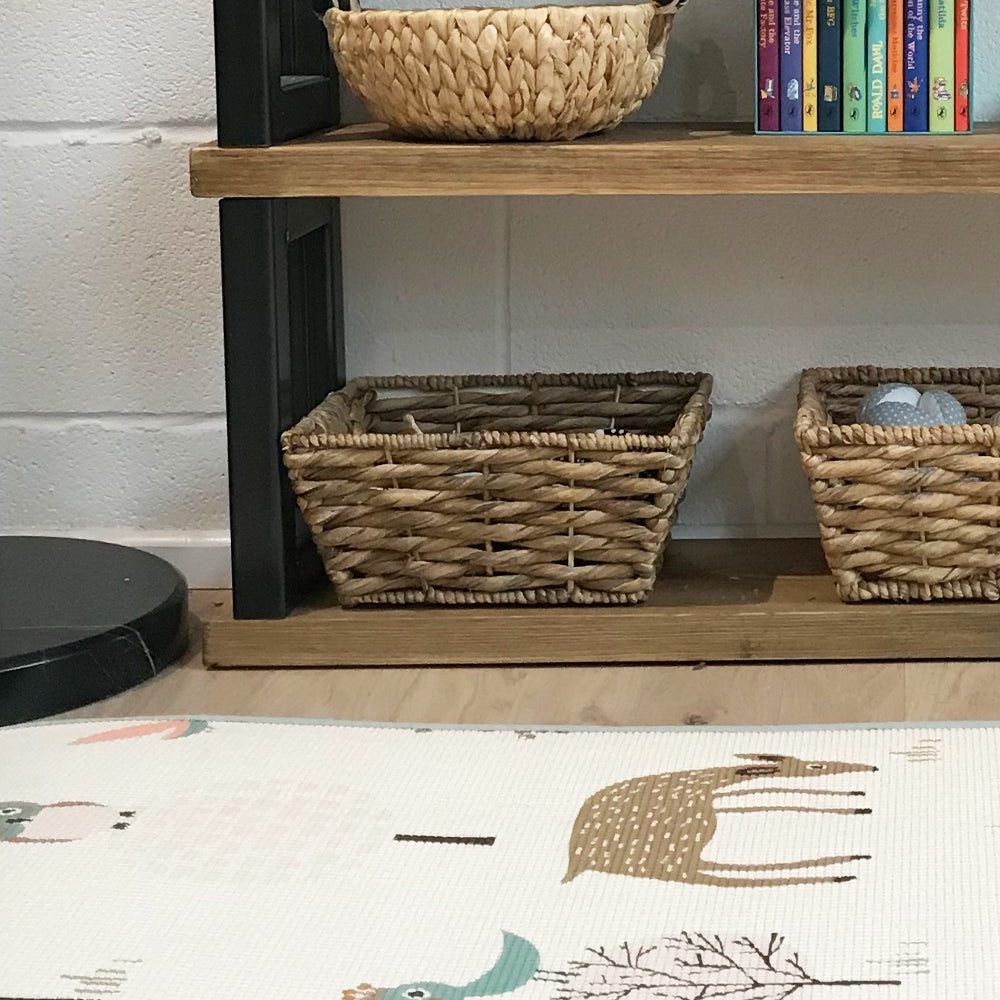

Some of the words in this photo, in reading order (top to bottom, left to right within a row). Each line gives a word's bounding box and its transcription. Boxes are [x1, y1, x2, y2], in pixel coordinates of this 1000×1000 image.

[768, 8, 776, 26] and
[806, 10, 813, 24] Mr
[826, 6, 835, 27] BFG
[908, 10, 916, 20] of
[758, 14, 768, 48] Factory
[768, 28, 776, 44] the
[806, 27, 814, 45] Fox
[908, 24, 916, 38] the
[872, 41, 884, 74] DAHL
[908, 41, 916, 70] World
[872, 78, 883, 120] ROALD
